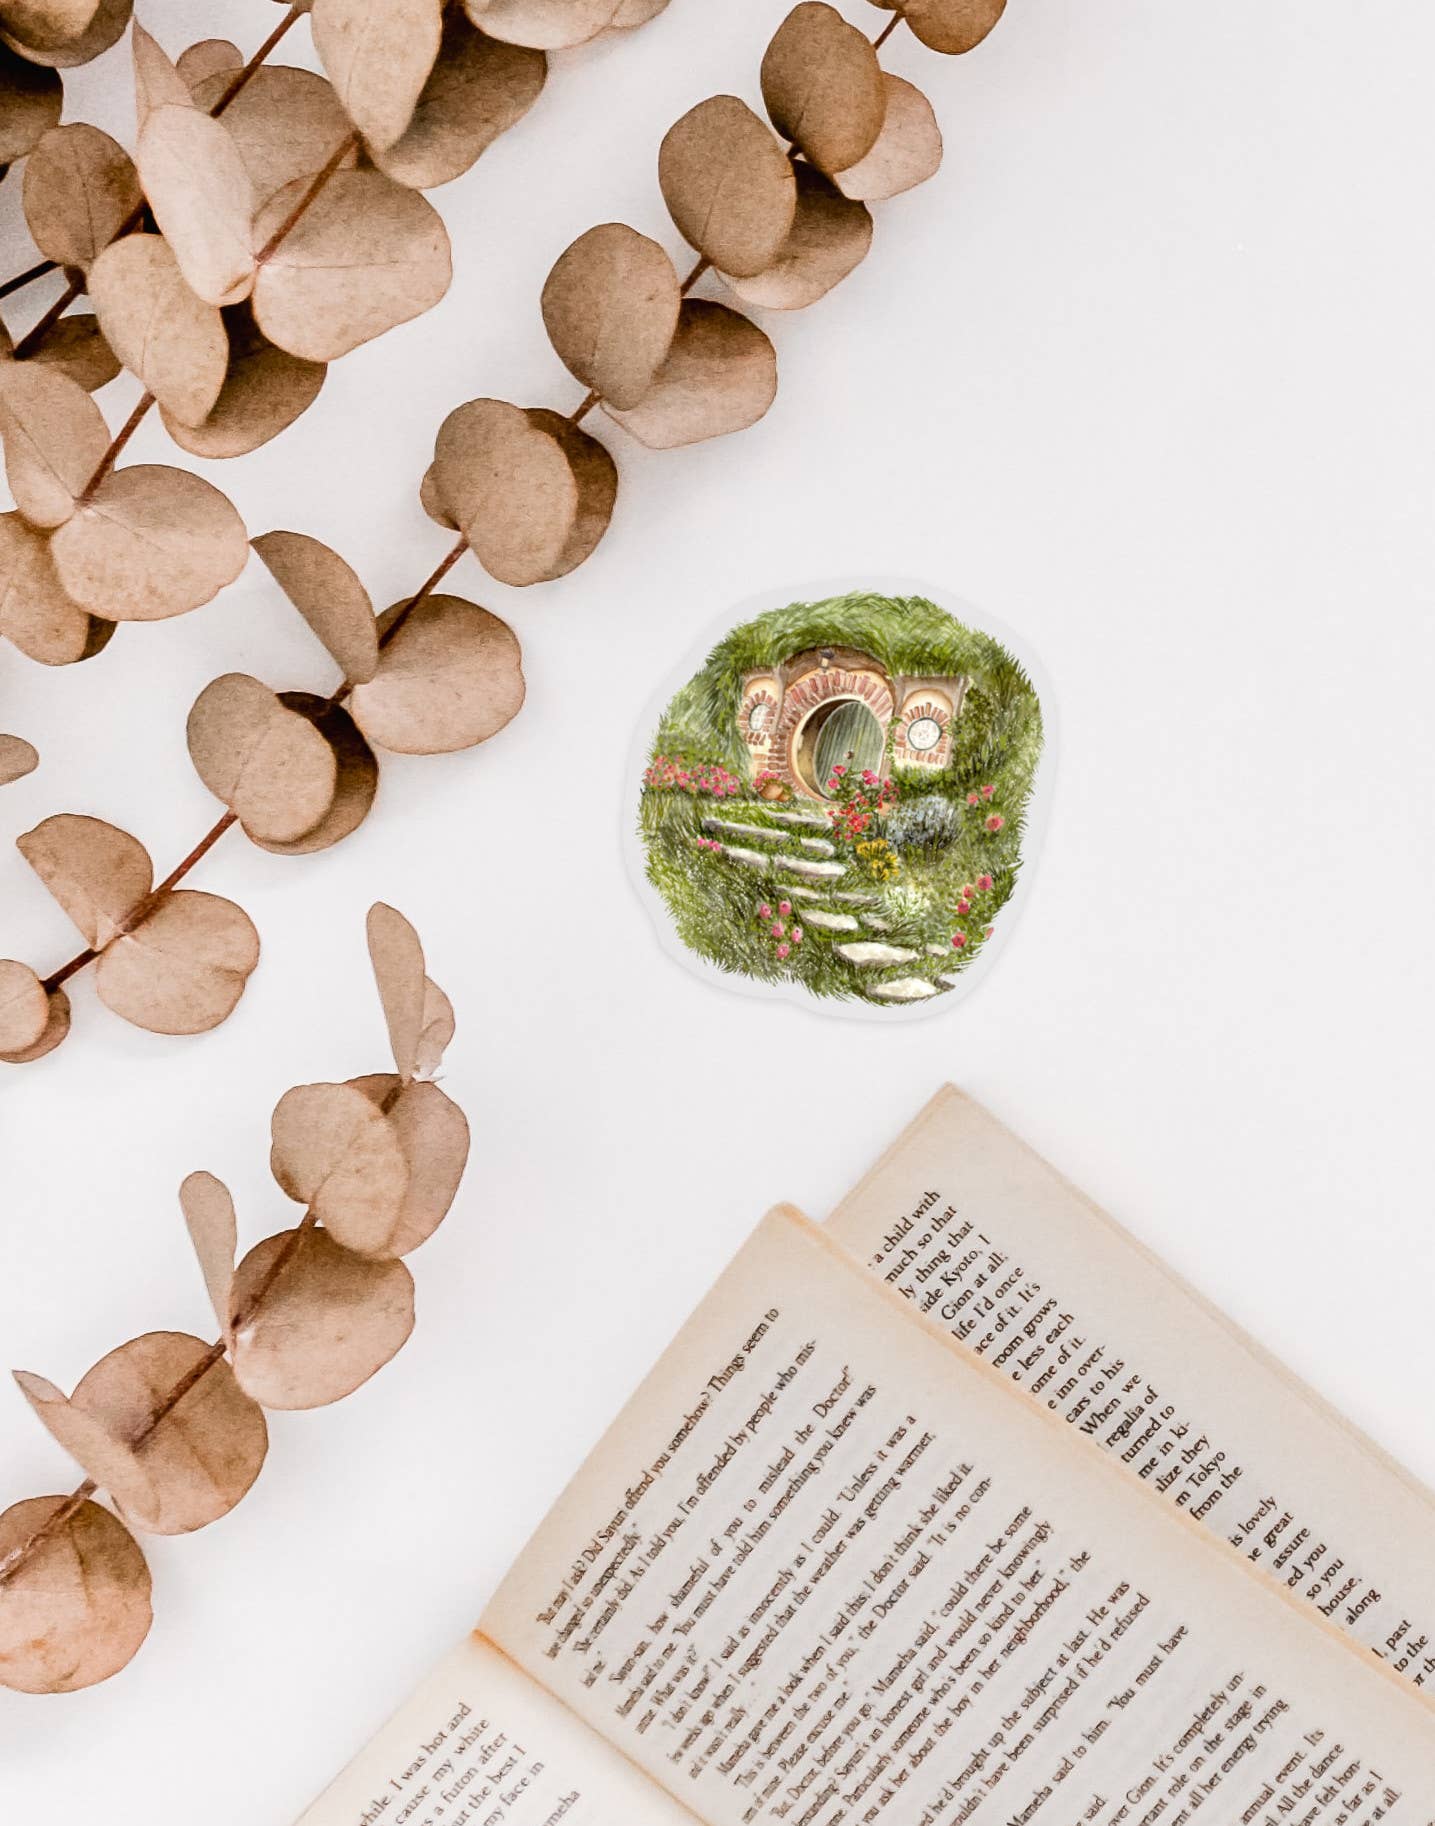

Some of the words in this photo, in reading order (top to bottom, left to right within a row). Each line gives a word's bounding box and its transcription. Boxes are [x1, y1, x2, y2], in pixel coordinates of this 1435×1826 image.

[874, 1253, 885, 1264] a
[883, 1216, 915, 1253] child
[911, 1191, 941, 1219] with
[915, 1249, 952, 1284] thing
[947, 1221, 974, 1248] that
[917, 1233, 933, 1250] so
[930, 1205, 957, 1233] that
[977, 1234, 991, 1245] I
[941, 1289, 975, 1320] Gion
[974, 1273, 989, 1289] at
[951, 1319, 977, 1341] life
[994, 1267, 1024, 1299] once
[994, 1312, 1009, 1333] of
[991, 1335, 1025, 1369] room
[1022, 1298, 1058, 1339] grows
[1016, 1345, 1046, 1371] less
[1045, 1313, 1075, 1345] each
[1057, 1344, 1072, 1365] of
[650, 1452, 672, 1474] you
[706, 1353, 746, 1393] Things
[764, 1308, 780, 1323] to
[1054, 1377, 1079, 1400] inn
[1065, 1396, 1091, 1424] cars
[1089, 1380, 1105, 1396] to
[1100, 1359, 1125, 1380] his
[1079, 1398, 1121, 1435] When
[1121, 1374, 1142, 1393] we
[1105, 1405, 1146, 1448] regalia
[1143, 1384, 1159, 1405] of
[696, 1441, 738, 1496] offended
[728, 1429, 750, 1446] by
[745, 1391, 778, 1435] people
[774, 1365, 798, 1391] who
[1120, 1416, 1163, 1464] turned
[1159, 1405, 1175, 1420] to
[1180, 1435, 1210, 1465] they
[723, 1517, 744, 1541] you
[758, 1445, 796, 1495] mislead
[794, 1423, 815, 1445] the
[745, 1520, 772, 1544] him
[768, 1461, 821, 1521] something
[812, 1439, 835, 1466] you
[825, 1407, 857, 1441] knew
[854, 1384, 877, 1408] was
[793, 1554, 807, 1569] as
[876, 1450, 889, 1462] it
[906, 1415, 917, 1425] a
[1185, 1451, 1226, 1488] Tokyo
[1189, 1489, 1223, 1521] from
[1220, 1466, 1243, 1490] the
[791, 1585, 813, 1606] the
[809, 1539, 848, 1585] weather
[845, 1517, 866, 1539] was
[863, 1476, 902, 1521] getting
[893, 1524, 924, 1556] think
[918, 1503, 940, 1526] she
[931, 1471, 964, 1505] liked
[1228, 1534, 1244, 1548] is
[1237, 1496, 1278, 1535] lovely
[1263, 1512, 1294, 1549] great
[857, 1619, 878, 1640] the
[871, 1578, 910, 1619] Doctor
[954, 1504, 971, 1522] no
[1272, 1527, 1310, 1570] assure
[1303, 1543, 1328, 1572] you
[1306, 1583, 1322, 1601] so
[1320, 1558, 1345, 1587] you
[871, 1648, 918, 1696] Mameha
[963, 1553, 994, 1585] there
[985, 1537, 1007, 1555] be
[1004, 1506, 1033, 1538] some
[910, 1667, 930, 1694] girl
[927, 1644, 948, 1672] and
[945, 1608, 979, 1648] would
[974, 1579, 1004, 1613] never
[996, 1520, 1054, 1580] knowingly
[977, 1658, 1002, 1681] her
[1069, 1551, 1091, 1573] the
[1345, 1588, 1382, 1626] along
[949, 1647, 982, 1676] been
[985, 1601, 1016, 1633] kind
[1010, 1592, 1026, 1606] to
[1032, 1676, 1081, 1733] surprised
[1109, 1591, 1151, 1641] refused
[1385, 1619, 1412, 1652] past
[1393, 1657, 1409, 1673] to
[1406, 1635, 1429, 1658] the
[947, 1747, 991, 1791] brought
[987, 1731, 1007, 1748] up
[1020, 1667, 1058, 1711] subject
[1085, 1606, 1110, 1627] He
[1107, 1581, 1130, 1604] was
[1051, 1756, 1075, 1784] said
[1135, 1655, 1164, 1686] must
[1157, 1625, 1189, 1655] have
[390, 1779, 403, 1791] I
[400, 1756, 426, 1781] was
[420, 1731, 448, 1756] hot
[447, 1701, 472, 1732] and
[478, 1732, 507, 1765] after
[1167, 1773, 1190, 1798] role
[1189, 1756, 1206, 1773] on
[1203, 1732, 1225, 1754] the
[1224, 1700, 1253, 1732] stage
[1172, 1690, 1229, 1754] completely
[395, 1785, 430, 1825] cause
[431, 1759, 455, 1782] my
[453, 1719, 489, 1756] white
[439, 1767, 479, 1805] futon
[467, 1786, 492, 1810] the
[485, 1755, 518, 1785] best
[512, 1744, 527, 1756] I
[1189, 1789, 1205, 1810] all
[1197, 1772, 1223, 1795] her
[1220, 1733, 1258, 1774] energy
[1252, 1699, 1290, 1735] trying
[1240, 1782, 1276, 1826] annual
[1303, 1730, 1325, 1747] Its
[1276, 1795, 1297, 1816] All
[1291, 1778, 1314, 1799] the
[1308, 1743, 1345, 1780] dance
[434, 1806, 445, 1816] a
[498, 1777, 530, 1807] face
[1314, 1785, 1340, 1807] felt
[1334, 1812, 1348, 1826] as
[1341, 1793, 1363, 1813] far
[1361, 1781, 1377, 1796] as
[1369, 1770, 1383, 1781] I
[1372, 1806, 1386, 1821] at
